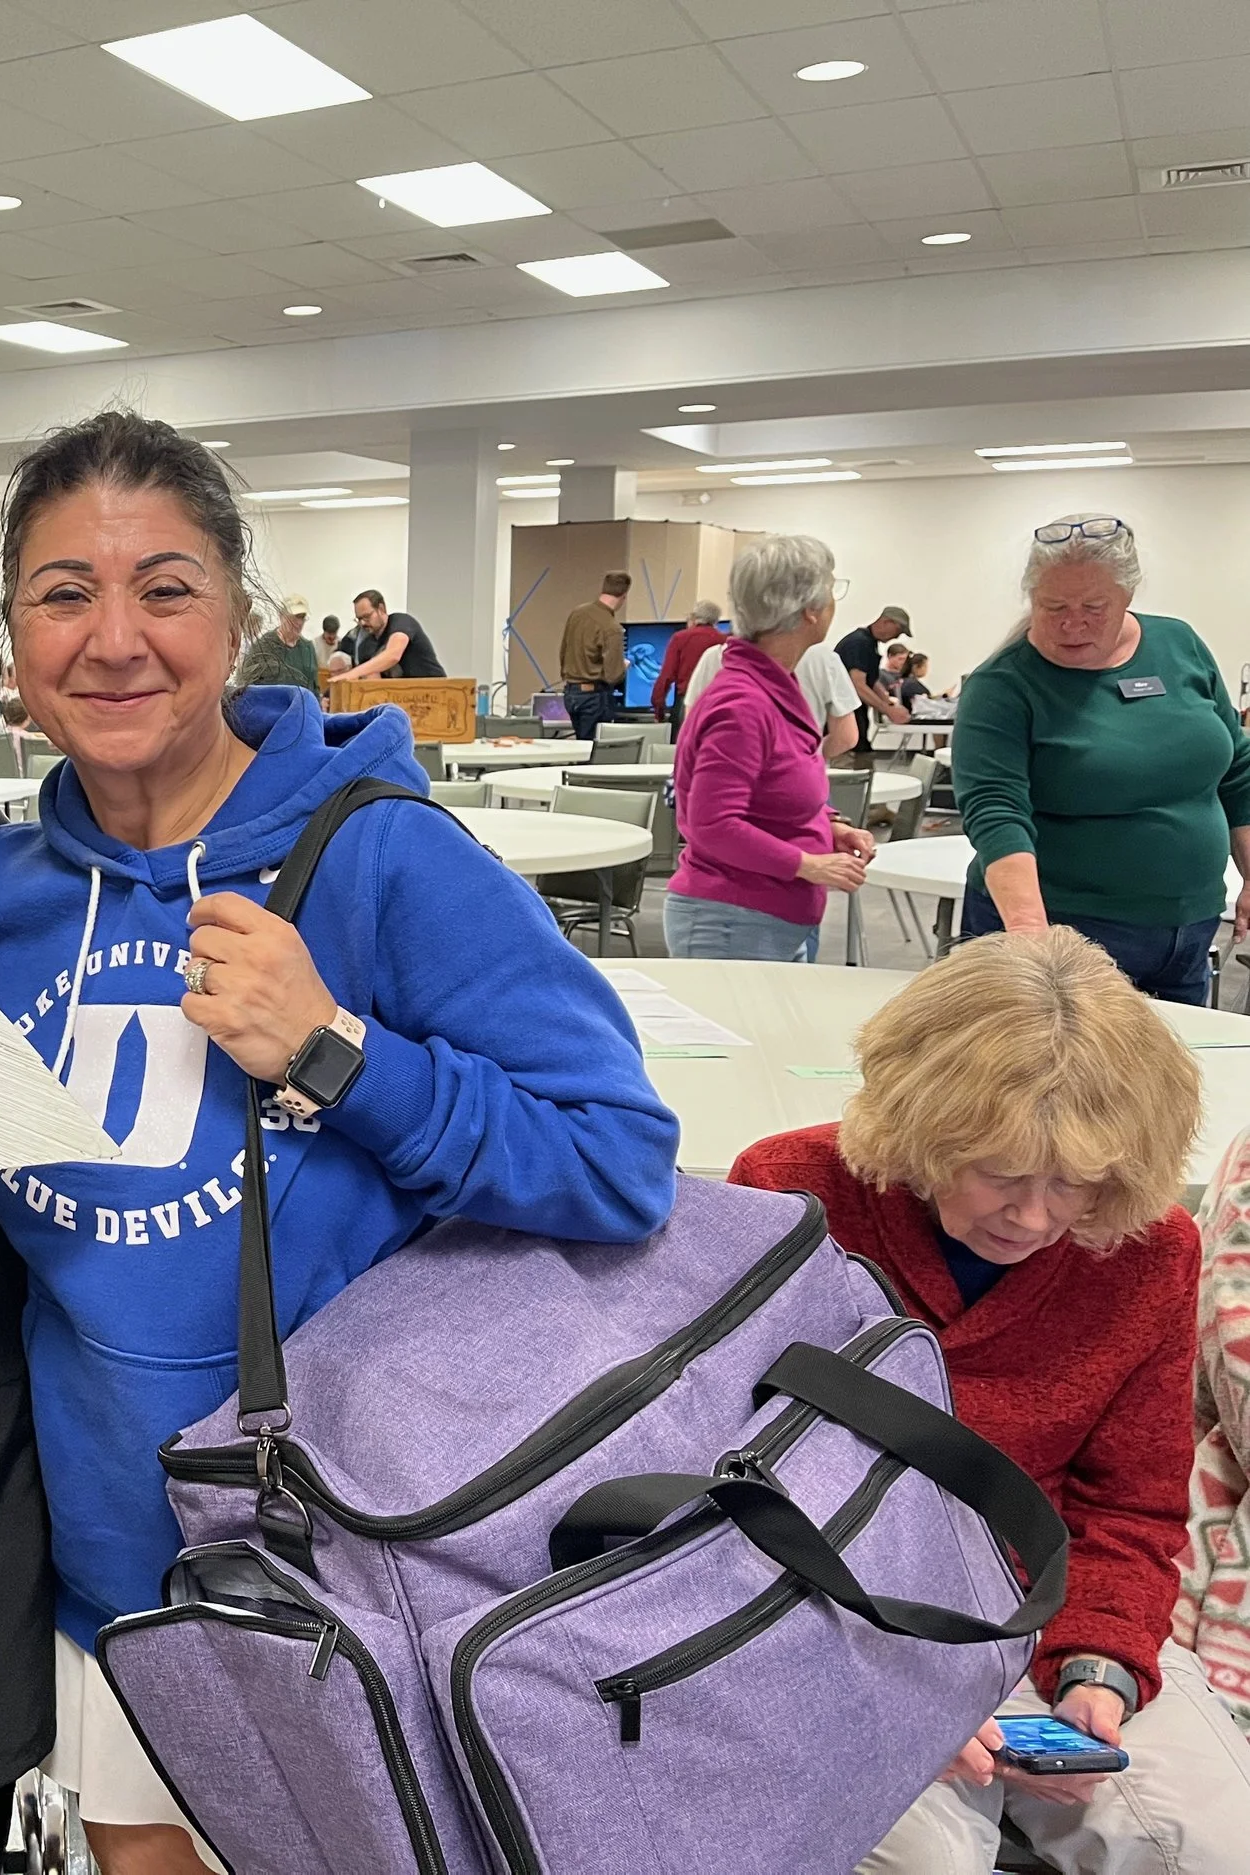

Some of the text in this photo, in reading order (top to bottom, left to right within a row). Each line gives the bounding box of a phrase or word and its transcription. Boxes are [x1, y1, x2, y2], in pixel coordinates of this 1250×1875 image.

[14, 940, 193, 1036] UKE UNIVE
[0, 1166, 78, 1231] LUE
